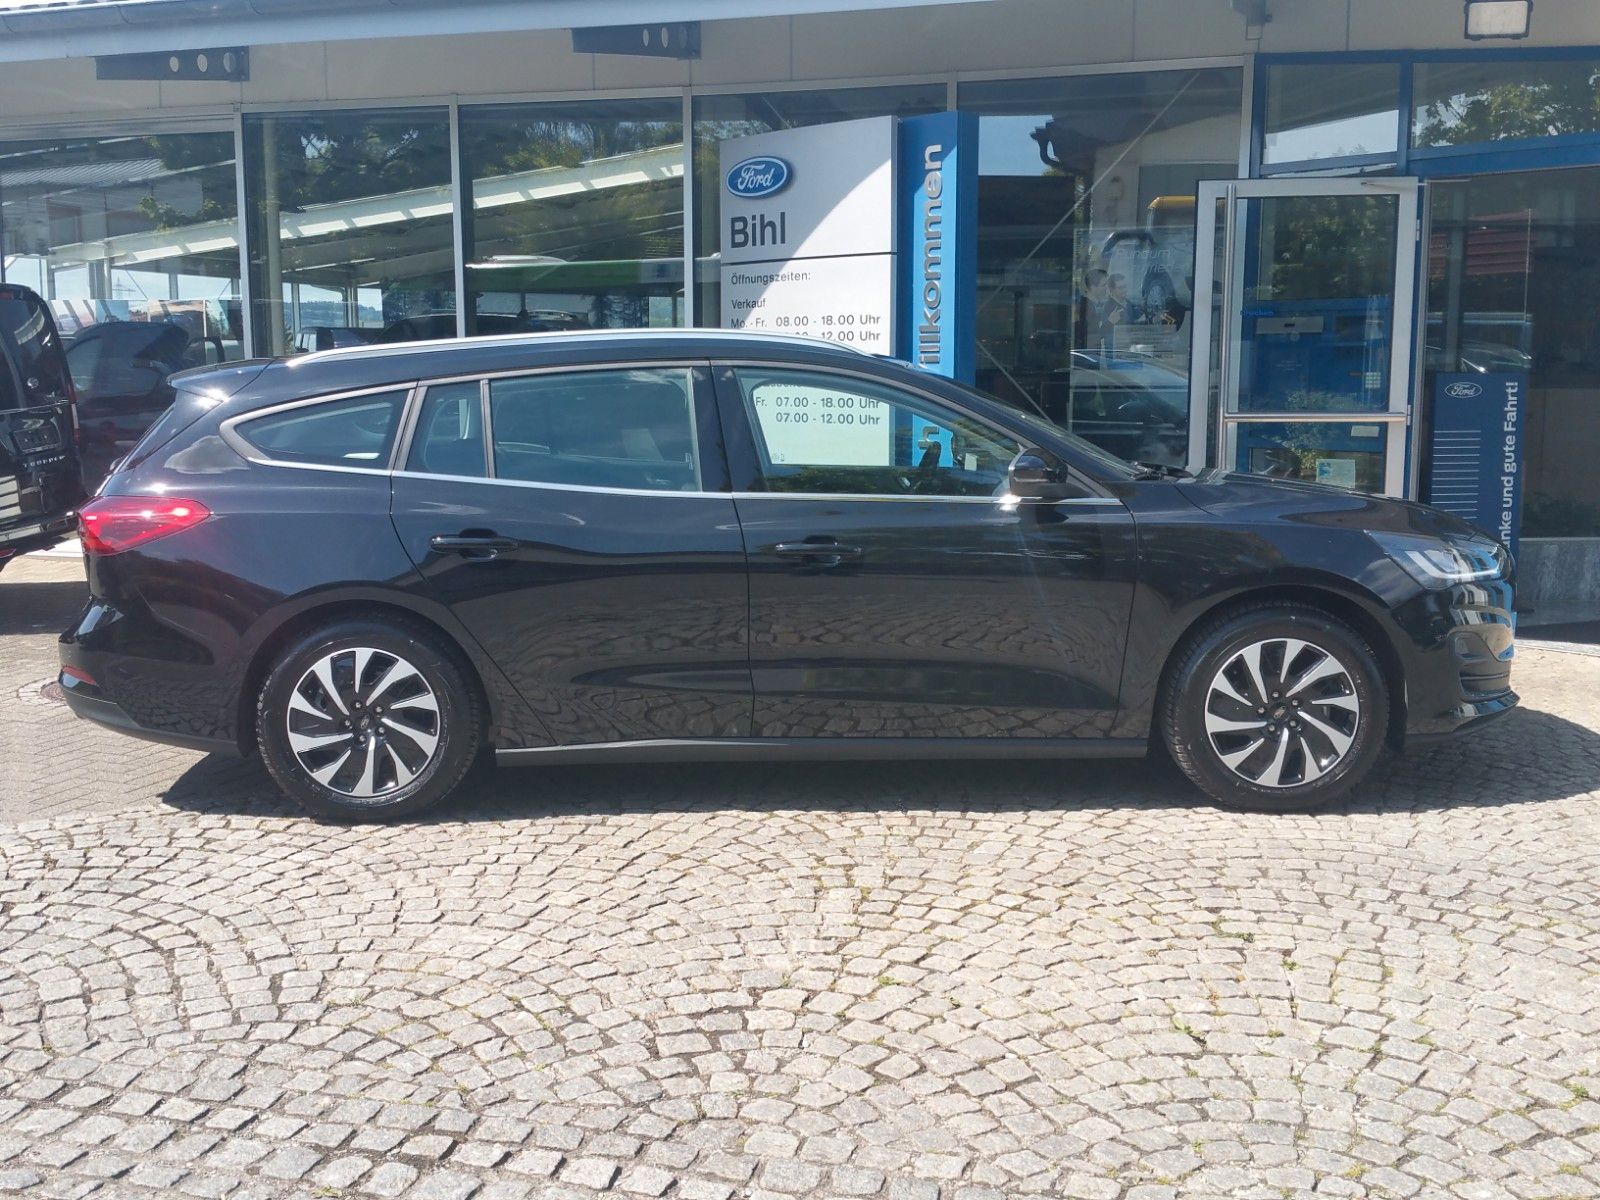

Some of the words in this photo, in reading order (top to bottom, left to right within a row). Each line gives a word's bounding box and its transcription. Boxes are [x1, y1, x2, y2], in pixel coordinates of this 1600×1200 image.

[730, 211, 786, 249] Bihl
[919, 144, 943, 367] illkommen
[731, 272, 812, 286] Öffnungszeiten:
[731, 297, 767, 310] Verkauf
[731, 318, 748, 329] Mo.
[755, 317, 768, 328] Fr.
[775, 316, 809, 327] 08.00
[821, 315, 854, 326] 18.00
[859, 314, 881, 325] Uhr
[821, 331, 854, 342] 12.00
[859, 331, 881, 342] Uhr
[755, 397, 768, 407] Fr.
[775, 396, 809, 408] 07.00
[820, 397, 854, 409] 18.00
[859, 398, 880, 409] Uhr
[1503, 381, 1519, 432] Fahrt!
[775, 412, 809, 423] 07.00
[820, 413, 854, 425] 12.00
[859, 414, 881, 425] Uhr
[1503, 434, 1517, 474] gute
[1501, 476, 1514, 508] und
[1498, 511, 1512, 548] anke
